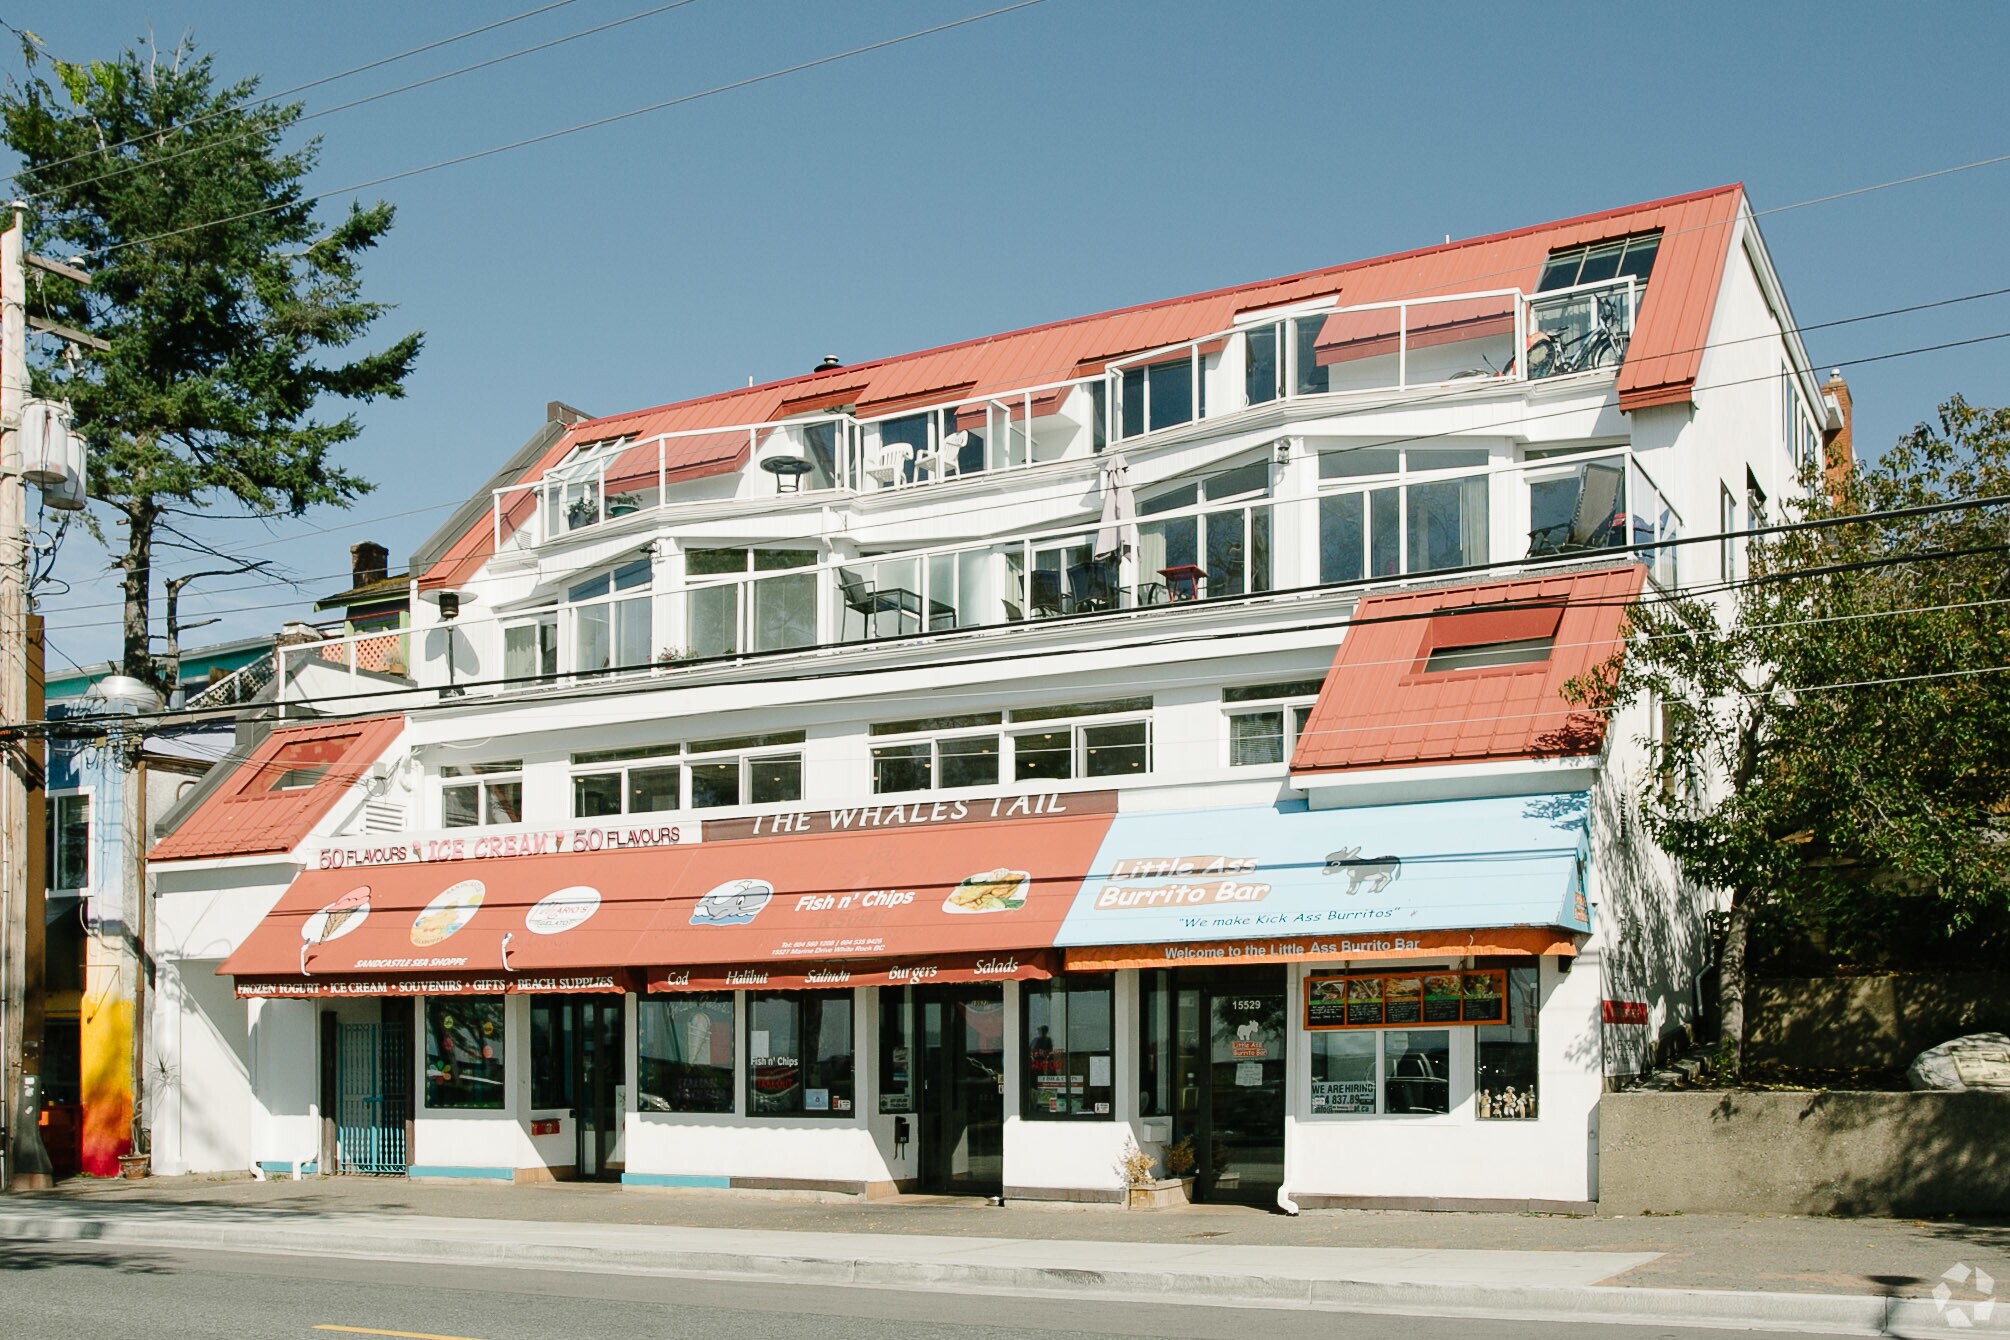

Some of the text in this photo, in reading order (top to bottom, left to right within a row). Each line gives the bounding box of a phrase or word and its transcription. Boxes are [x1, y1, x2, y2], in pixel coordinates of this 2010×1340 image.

[752, 811, 811, 835] THE
[990, 792, 1067, 817] TAIL
[319, 827, 681, 869] 50 FLAVOURS ICE CREAM 50 FLAVOURS
[1111, 856, 1259, 881] Little Ass
[794, 894, 836, 912] Fish
[861, 890, 916, 909] Chips
[1098, 881, 1271, 907] Burrito Bar
[1213, 915, 1250, 927] make
[1255, 913, 1289, 925] Kick
[1293, 912, 1322, 923] Ass
[1164, 938, 1421, 959] Welcome to the Little Ass Burrito Bar
[353, 957, 469, 969] SANDCASTLE SEA SHOPPE
[667, 971, 690, 985] Cod
[725, 969, 769, 985] Halibut
[804, 968, 851, 984] Salmon
[888, 964, 938, 985] Burgers
[973, 957, 1019, 976] Salads
[237, 976, 615, 995] FROZEN YOGURT ICE CREAM SOUVENIRS GIFTS BEACH SUPPLIES
[1232, 1000, 1261, 1010] 15529
[1232, 1041, 1250, 1049] Little
[1232, 1049, 1255, 1057] Burrito
[750, 1056, 767, 1066] Fish
[777, 1056, 799, 1068] Chips
[1312, 1083, 1374, 1094] WE ARE HIRING
